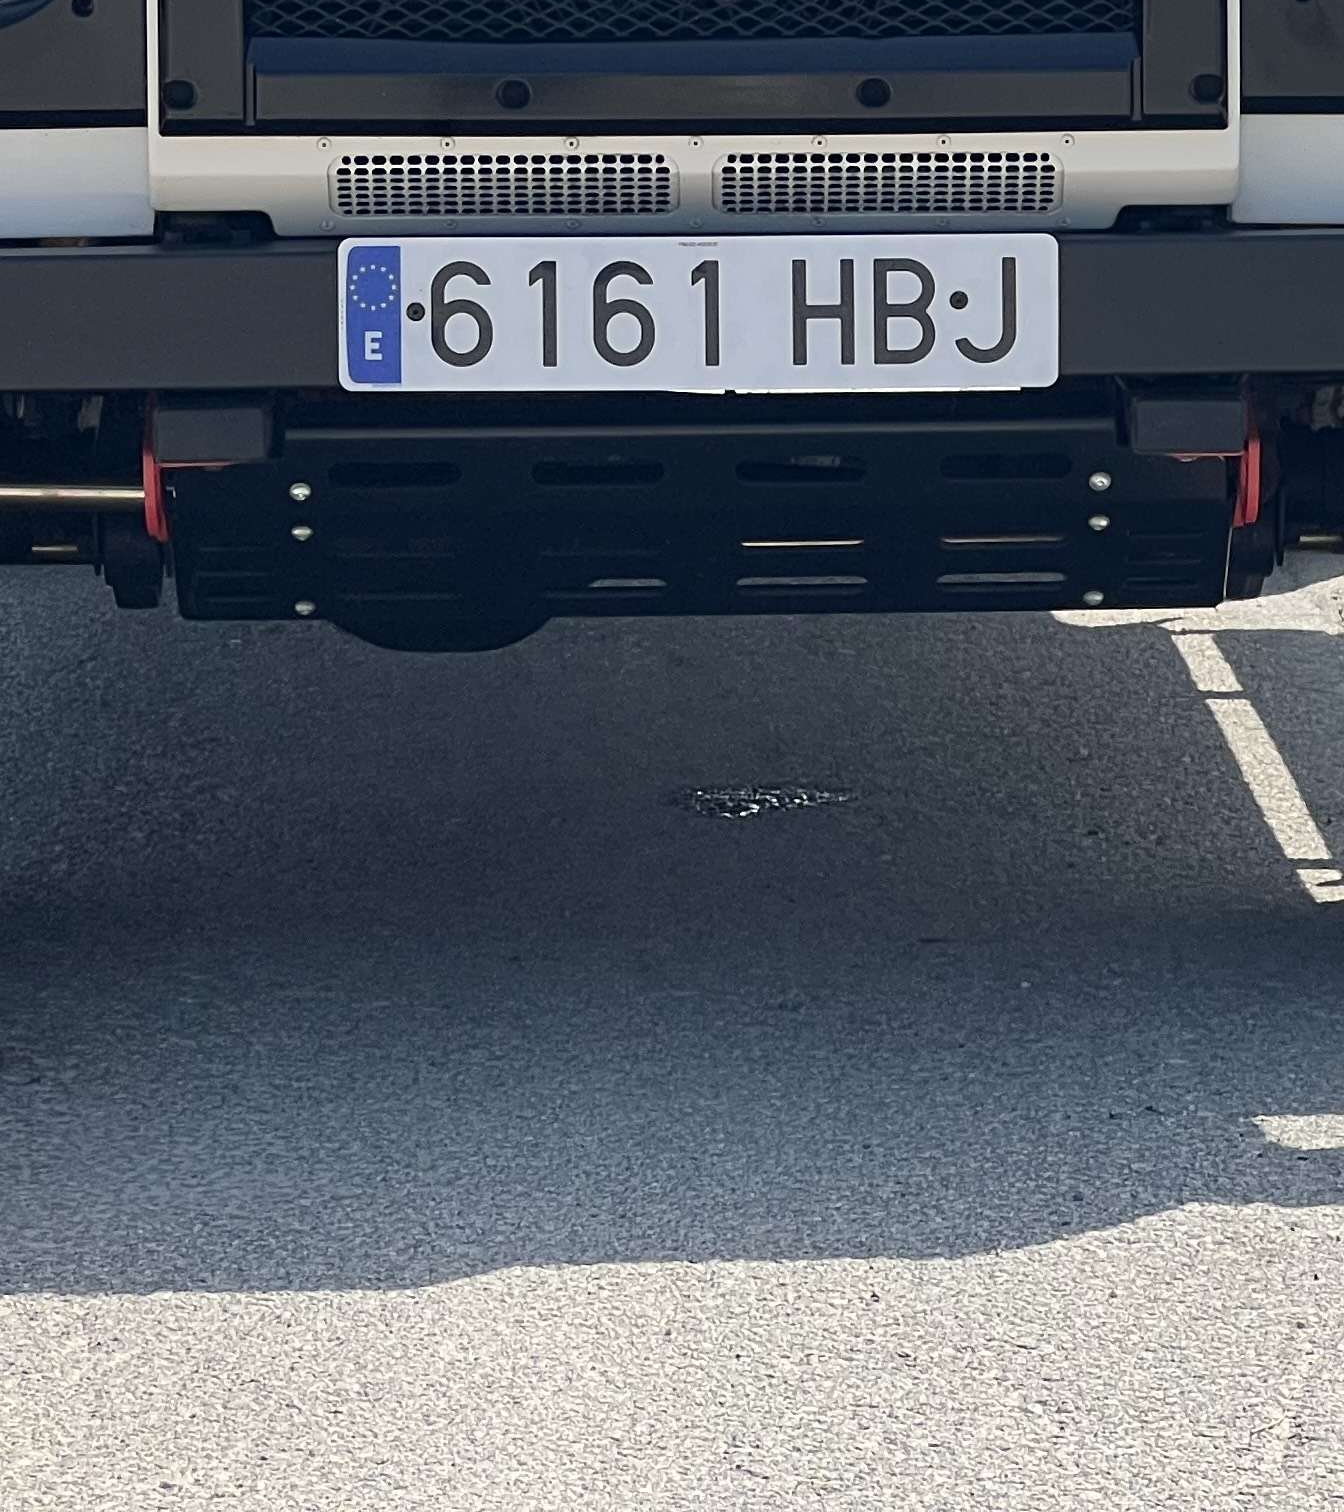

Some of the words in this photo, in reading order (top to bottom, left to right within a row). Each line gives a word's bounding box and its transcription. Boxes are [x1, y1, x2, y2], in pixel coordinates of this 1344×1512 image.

[364, 331, 383, 361] E
[430, 260, 720, 368] 6161
[792, 257, 1017, 366] HBJ
